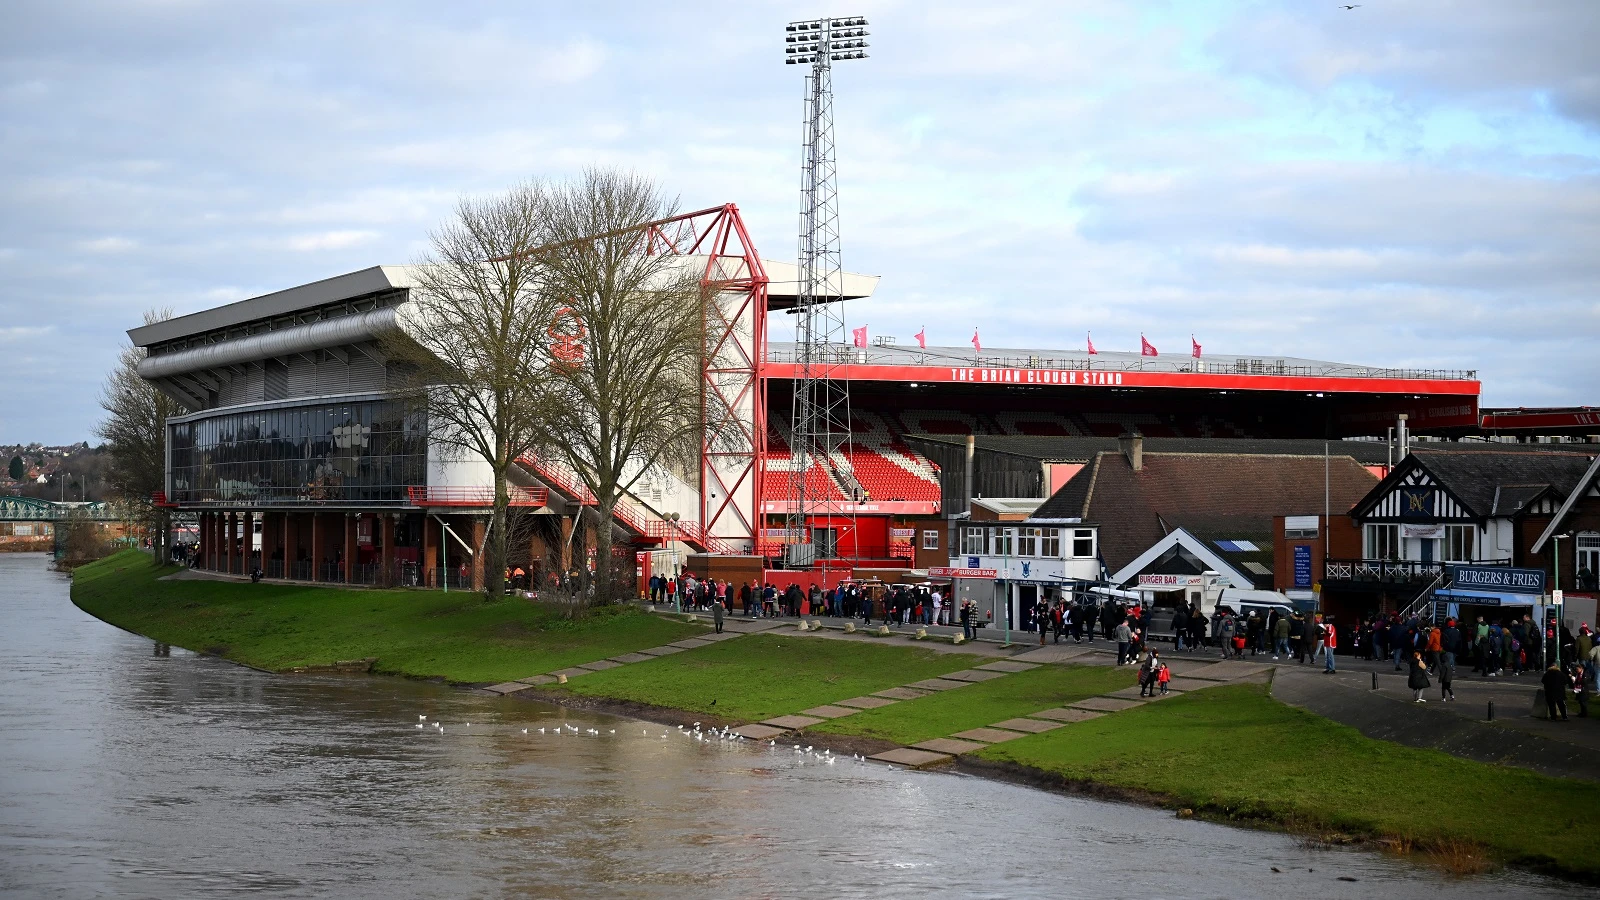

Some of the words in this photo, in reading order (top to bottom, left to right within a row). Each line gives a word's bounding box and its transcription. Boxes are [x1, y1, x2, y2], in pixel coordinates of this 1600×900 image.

[951, 368, 974, 381] THE
[981, 369, 1021, 383] BRIAN
[1027, 370, 1076, 384] CLOUGH
[1083, 372, 1122, 385] STAND
[1459, 405, 1471, 415] 1865
[1573, 413, 1594, 424] THE
[1140, 575, 1163, 584] BURGER
[1164, 576, 1177, 584] BAR
[1459, 570, 1502, 584] BURGERS
[1503, 573, 1510, 584] &
[1511, 573, 1540, 586] FRIES
